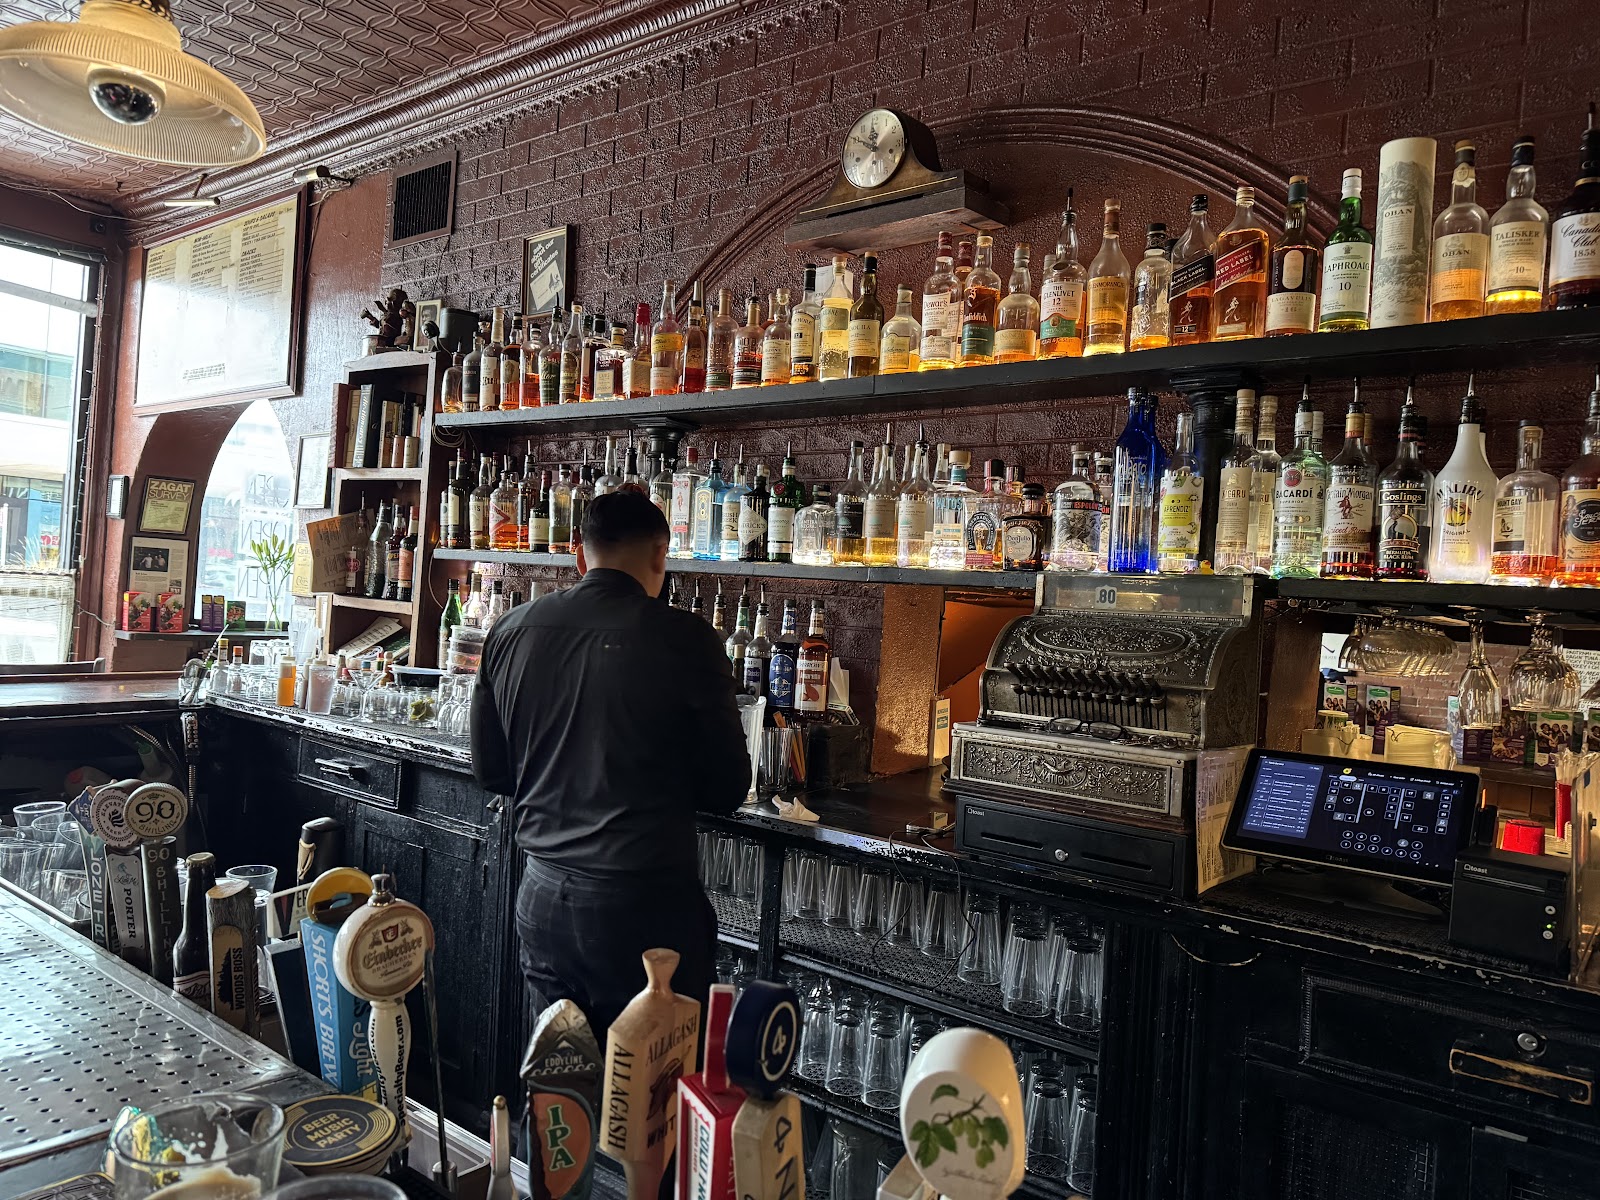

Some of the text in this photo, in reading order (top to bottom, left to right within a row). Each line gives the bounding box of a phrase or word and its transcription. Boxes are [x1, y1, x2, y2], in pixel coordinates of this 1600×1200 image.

[1384, 207, 1413, 218] OBAN
[1494, 230, 1540, 241] TALISKER
[531, 238, 555, 264] about our
[1442, 249, 1470, 258] OBAN
[1216, 264, 1230, 276] RED
[1230, 255, 1254, 270] LABEL
[1324, 260, 1370, 274] LAPHROAIG
[1515, 265, 1525, 274] 10
[1170, 275, 1188, 286] BLACK
[1338, 282, 1352, 291] 10
[1044, 290, 1075, 300] GLENLIVET
[1052, 298, 1061, 306] 12
[150, 481, 192, 492] ZAGAT
[1348, 486, 1372, 501] Morgan
[1436, 483, 1485, 502] MALIBU
[149, 490, 190, 500] SURVEY
[1382, 492, 1422, 504] Goslings
[1510, 498, 1522, 506] GAY
[1040, 769, 1080, 786] NATIONAL
[136, 800, 176, 824] 90
[106, 825, 122, 836] BEER
[138, 821, 177, 836] SHILLING
[148, 848, 170, 863] 90
[90, 848, 103, 900] LONE
[1471, 865, 1488, 874] toast
[124, 888, 136, 939] PORTER
[232, 948, 245, 1010] WOODS BOSS
[311, 930, 338, 1087] SHORTS BREW
[647, 1014, 698, 1066] ALLAGASH
[544, 1054, 584, 1068] EDDYLINE
[608, 1043, 634, 1150] ALLAGASH
[302, 1112, 341, 1132] BEER
[306, 1118, 354, 1142] MUSIC
[316, 1124, 362, 1148] PARTY
[546, 1104, 576, 1171] IPA
[647, 1115, 676, 1149] WHIT
